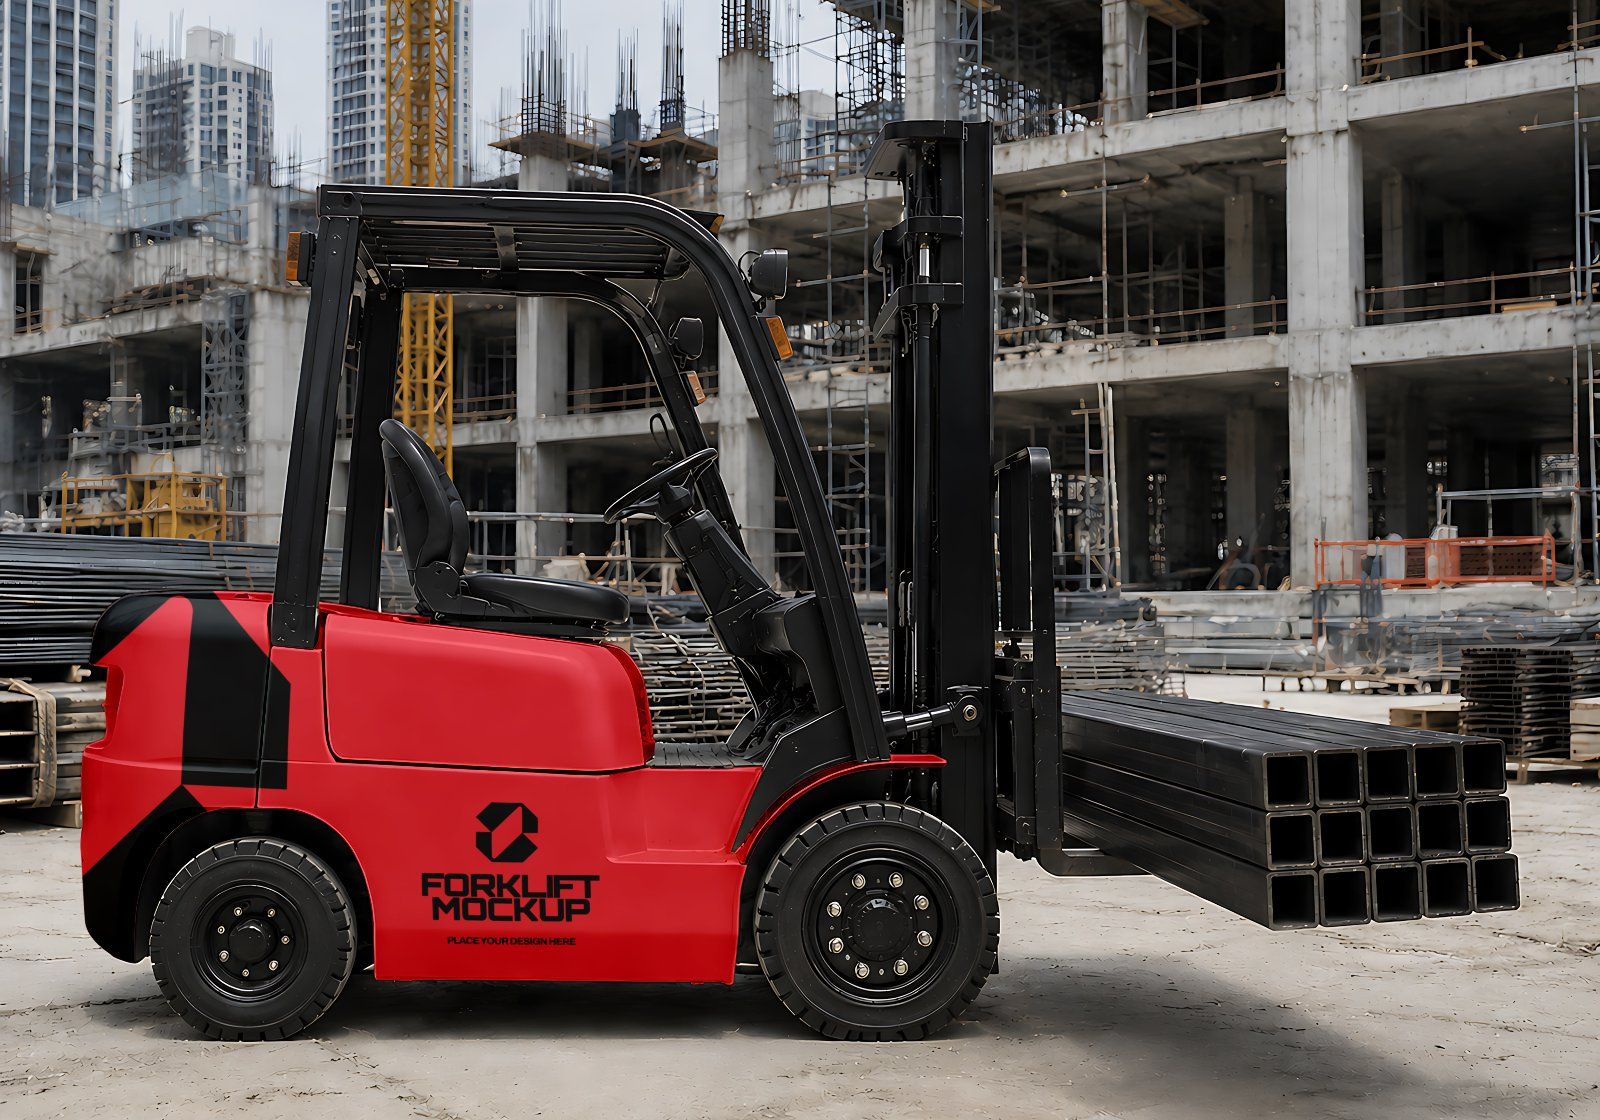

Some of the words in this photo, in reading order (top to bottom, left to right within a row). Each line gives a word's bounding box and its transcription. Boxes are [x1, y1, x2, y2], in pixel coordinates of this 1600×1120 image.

[422, 873, 600, 898] FORKLIFT
[432, 897, 591, 922] MOCKUP
[447, 936, 479, 945] PLACE
[481, 936, 509, 945] YOUR
[509, 937, 548, 946] DESIGN
[548, 937, 576, 946] HERE
